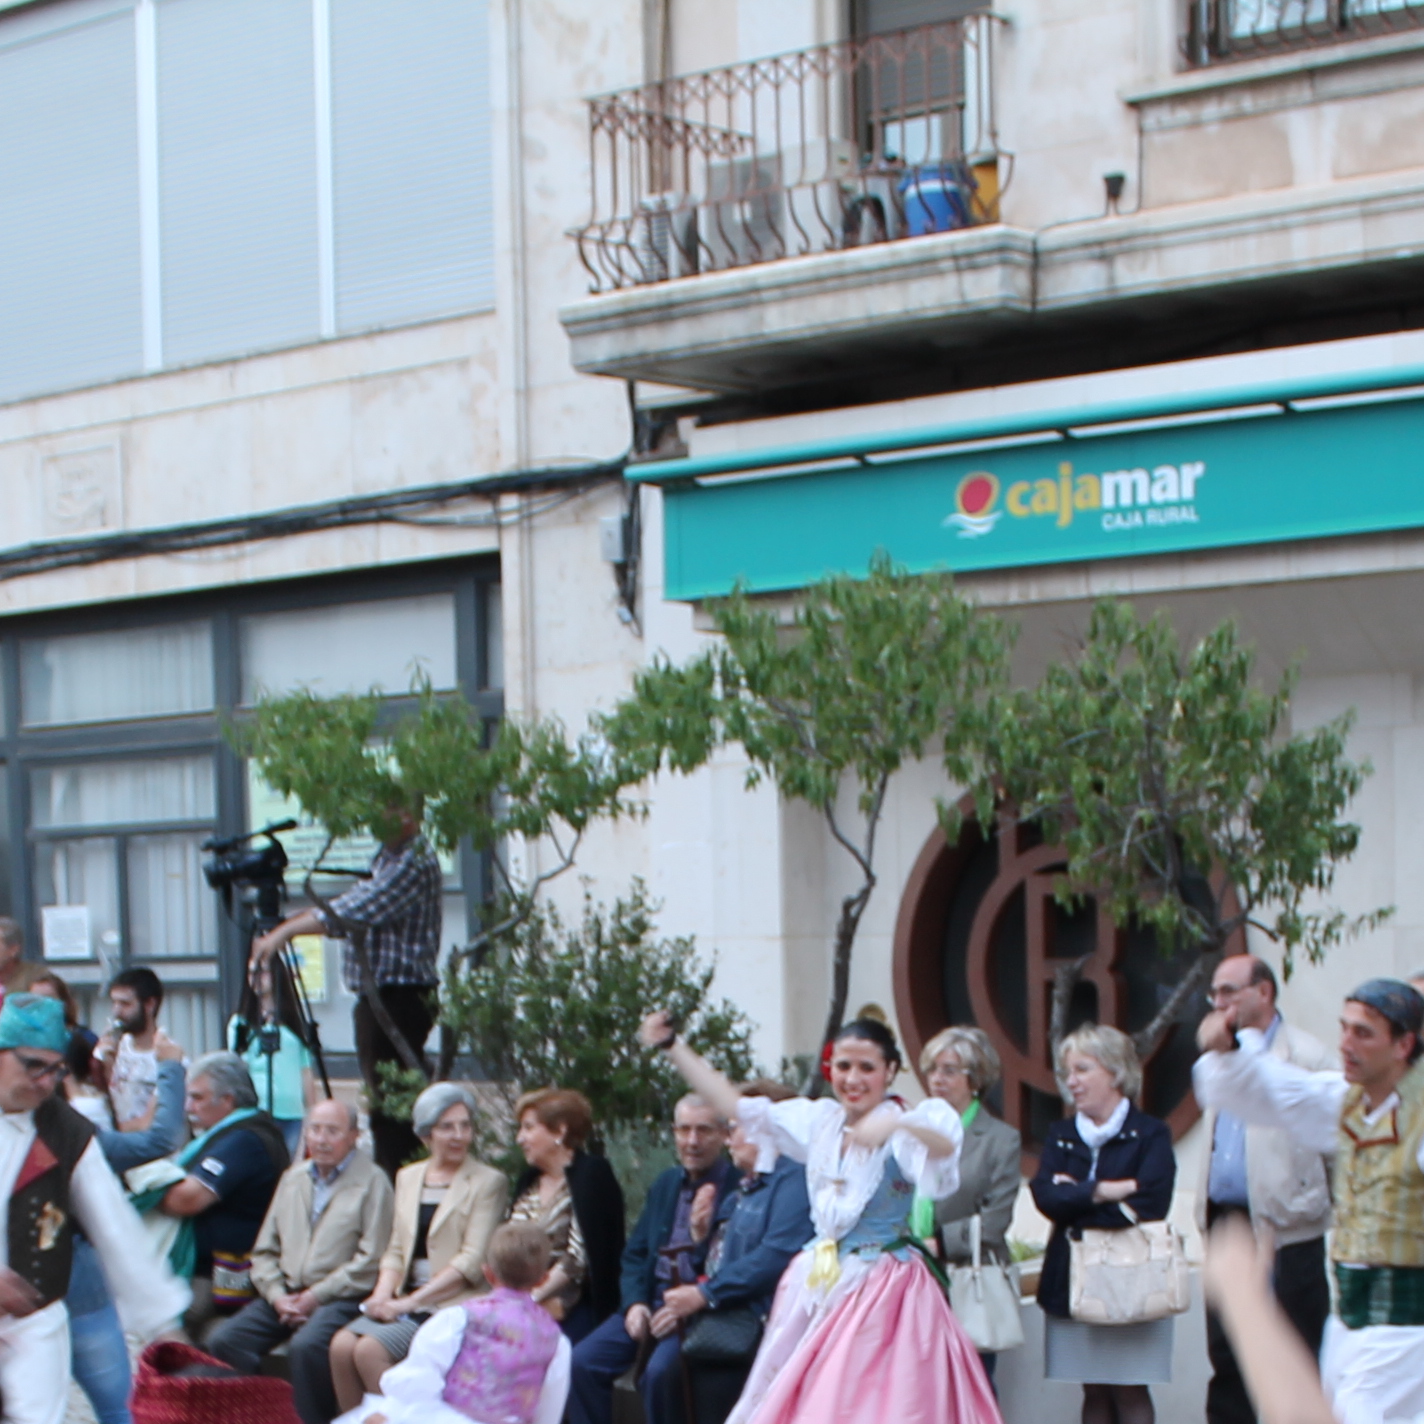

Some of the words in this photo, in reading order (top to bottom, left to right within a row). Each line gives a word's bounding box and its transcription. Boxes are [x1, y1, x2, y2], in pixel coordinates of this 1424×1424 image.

[1005, 460, 1206, 529] cajamar
[1102, 508, 1144, 532] CAJA
[1146, 504, 1199, 527] RURAL
